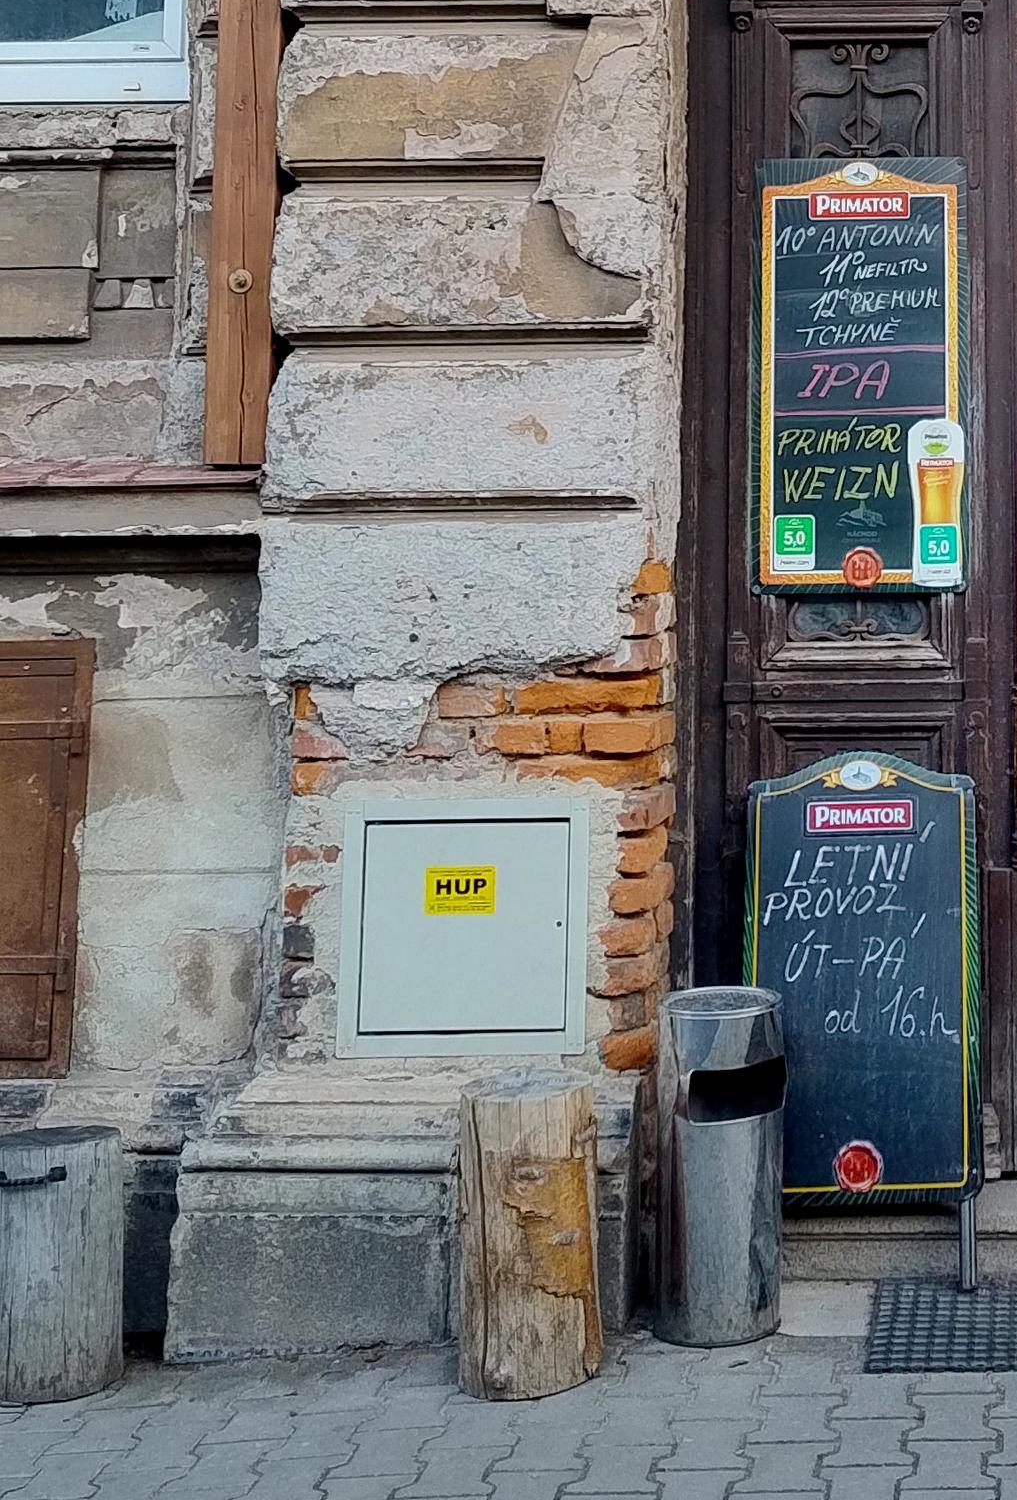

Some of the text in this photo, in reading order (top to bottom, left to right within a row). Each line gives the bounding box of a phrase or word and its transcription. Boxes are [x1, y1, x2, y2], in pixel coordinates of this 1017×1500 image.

[816, 195, 904, 216] PRIMATOR
[816, 215, 939, 253] ANTONÍN
[796, 317, 902, 348] TCHYNĚ
[796, 360, 892, 400] IPA
[777, 417, 902, 457] PRIMÁTOR
[783, 531, 806, 547] 5,0
[928, 539, 950, 556] 5,0
[815, 805, 906, 828] PRIMATOR
[783, 820, 936, 887] LETNÍ
[436, 878, 487, 895] HUP
[824, 989, 861, 1034] od
